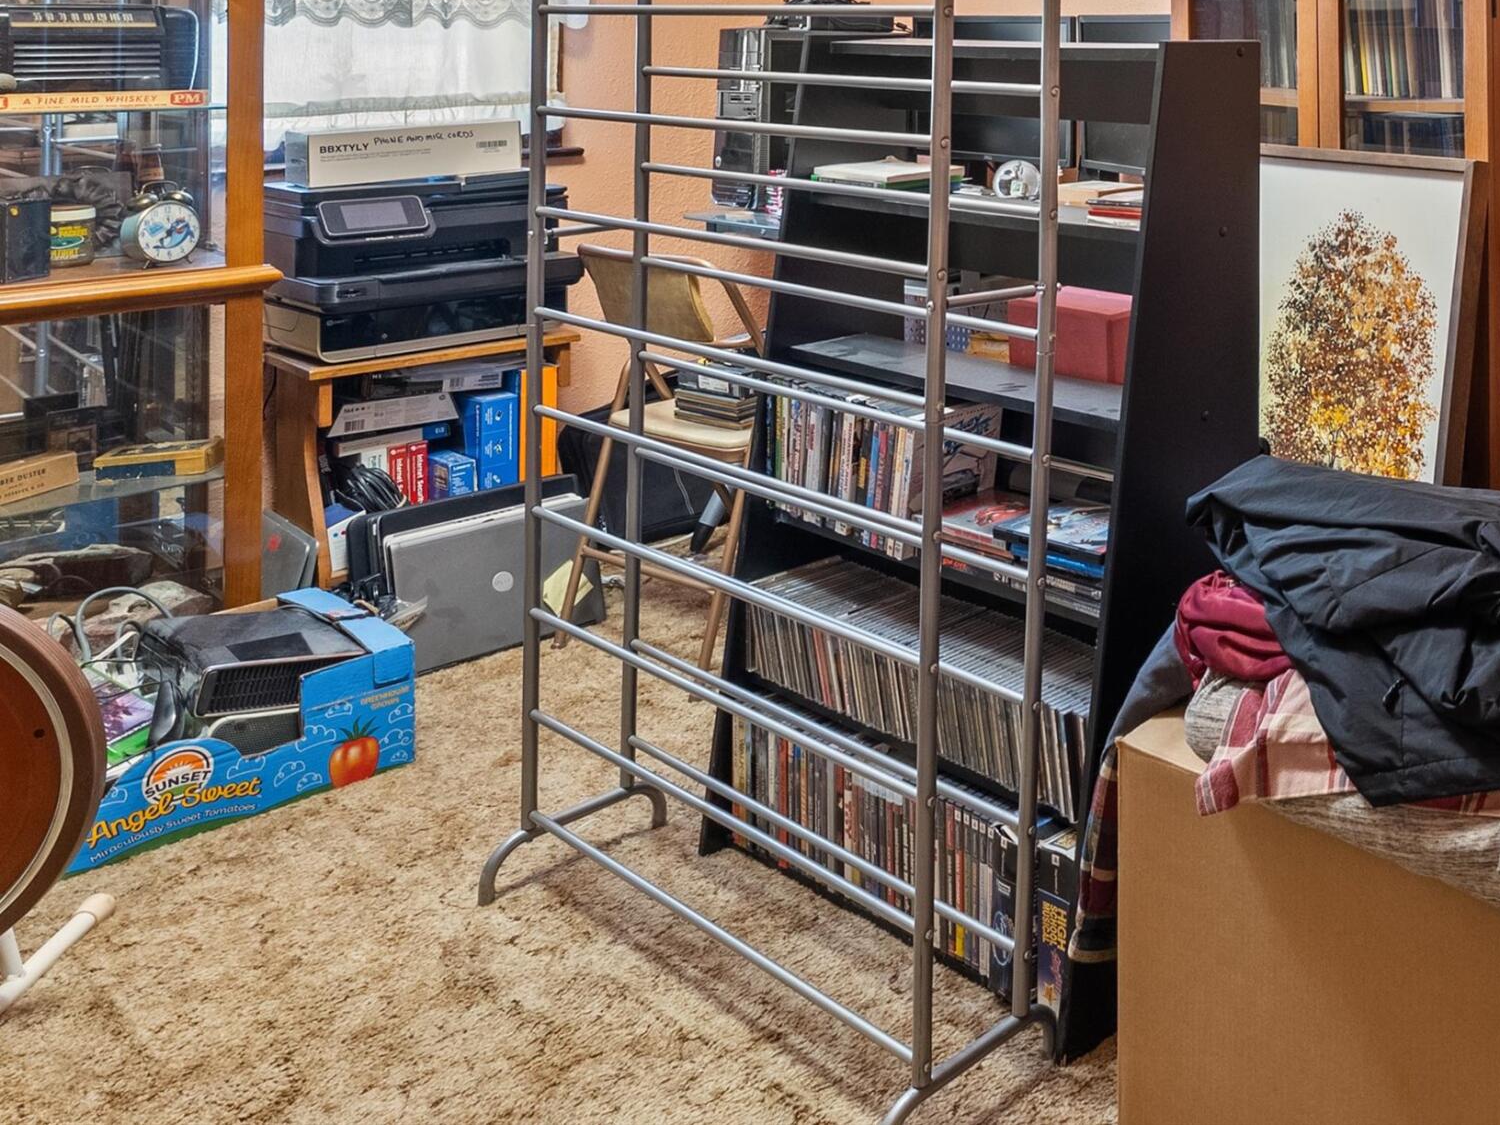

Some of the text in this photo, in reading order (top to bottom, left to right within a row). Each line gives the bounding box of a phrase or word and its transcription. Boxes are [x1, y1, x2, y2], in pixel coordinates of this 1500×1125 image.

[36, 96, 65, 105] FINE
[70, 95, 99, 105] MILD
[105, 94, 158, 104] WHISKEY
[319, 143, 369, 154] BBXTYLY
[17, 468, 46, 481] DUSTER
[145, 769, 212, 798] SUNSET
[86, 777, 262, 849] Angel Sweet
[90, 803, 257, 864] Miraculously Sweet Tomatoes
[1042, 900, 1050, 943] MUSICAL
[1049, 904, 1058, 946] SCHOOL
[1057, 906, 1067, 952] HIGH
